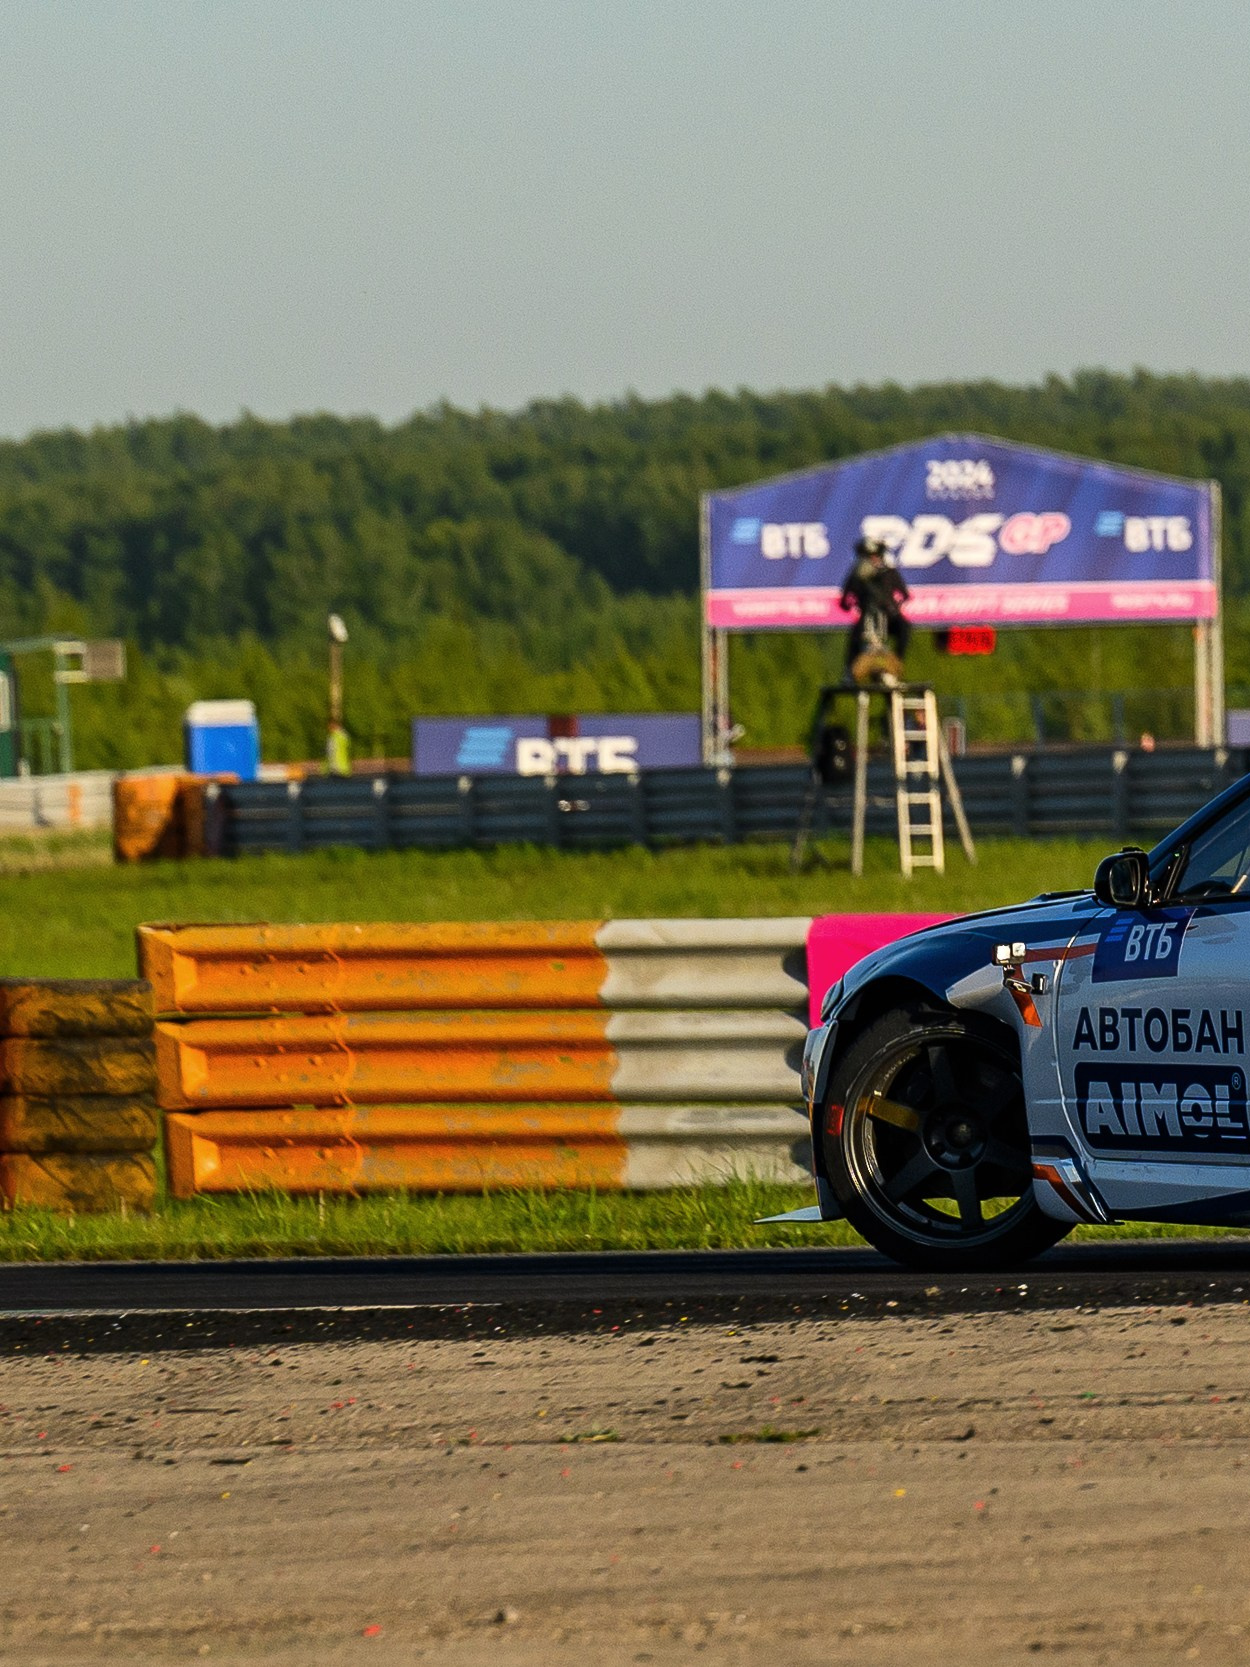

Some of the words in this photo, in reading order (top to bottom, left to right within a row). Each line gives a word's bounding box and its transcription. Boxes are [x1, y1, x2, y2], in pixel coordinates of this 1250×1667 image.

[762, 522, 830, 559] ВТБ
[1124, 516, 1192, 552] ВТБ
[1124, 922, 1178, 962] ВТБ
[1072, 1006, 1246, 1055] АВТОБАН
[1086, 1081, 1247, 1140] AIMOL
